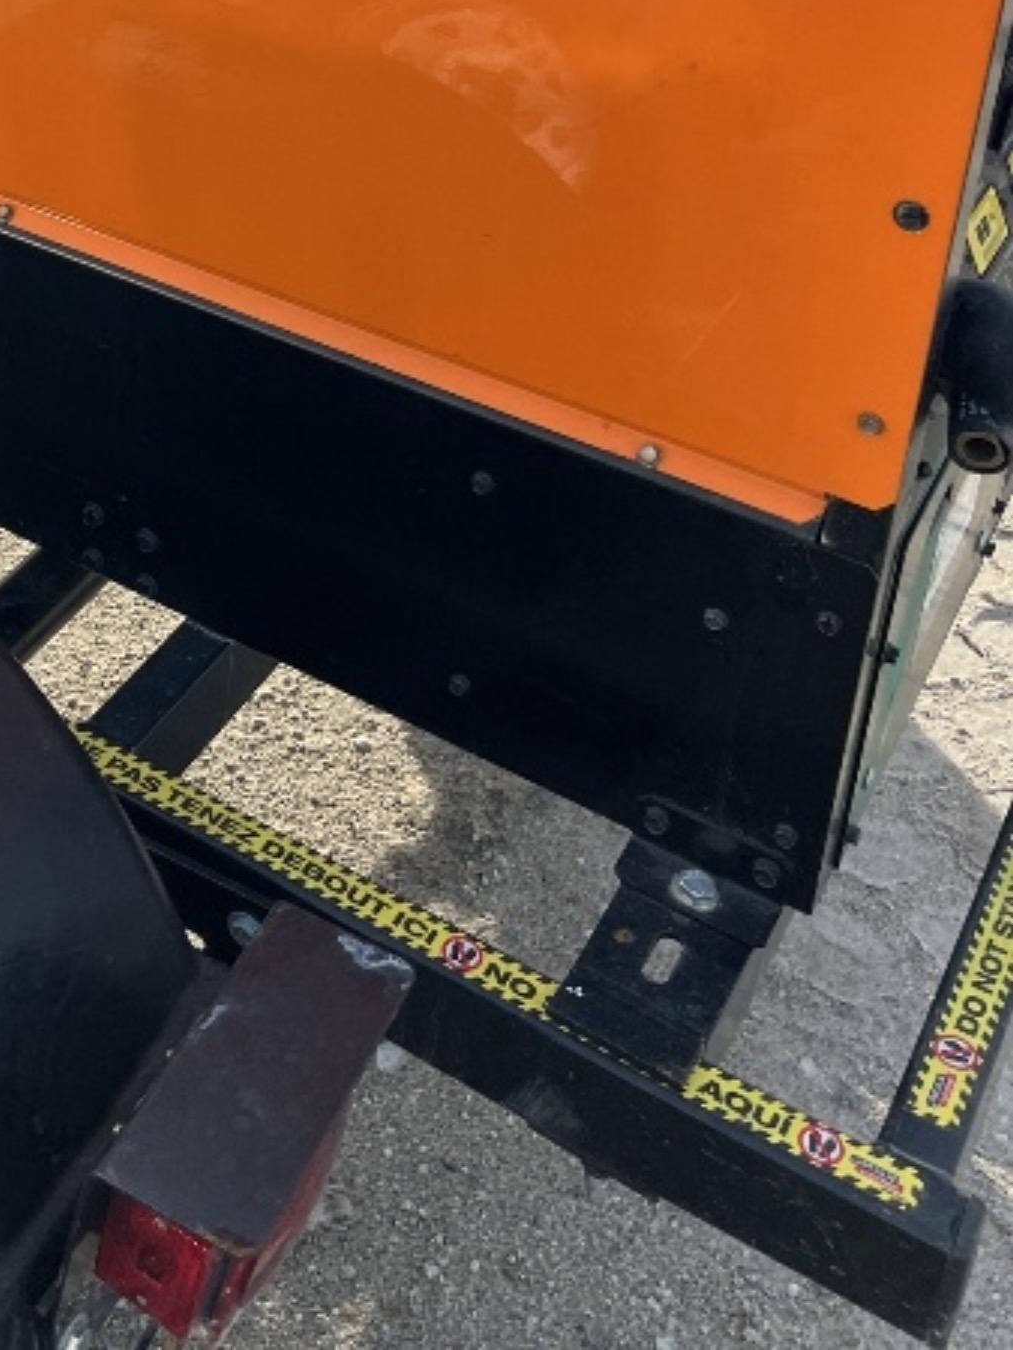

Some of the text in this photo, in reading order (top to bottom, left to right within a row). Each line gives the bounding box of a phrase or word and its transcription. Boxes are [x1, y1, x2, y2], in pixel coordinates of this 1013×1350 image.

[105, 755, 439, 946] PAS TENEZ DEBOUT ICI
[483, 962, 538, 1000] NO
[971, 936, 1009, 995] NOT
[956, 995, 988, 1036] DO
